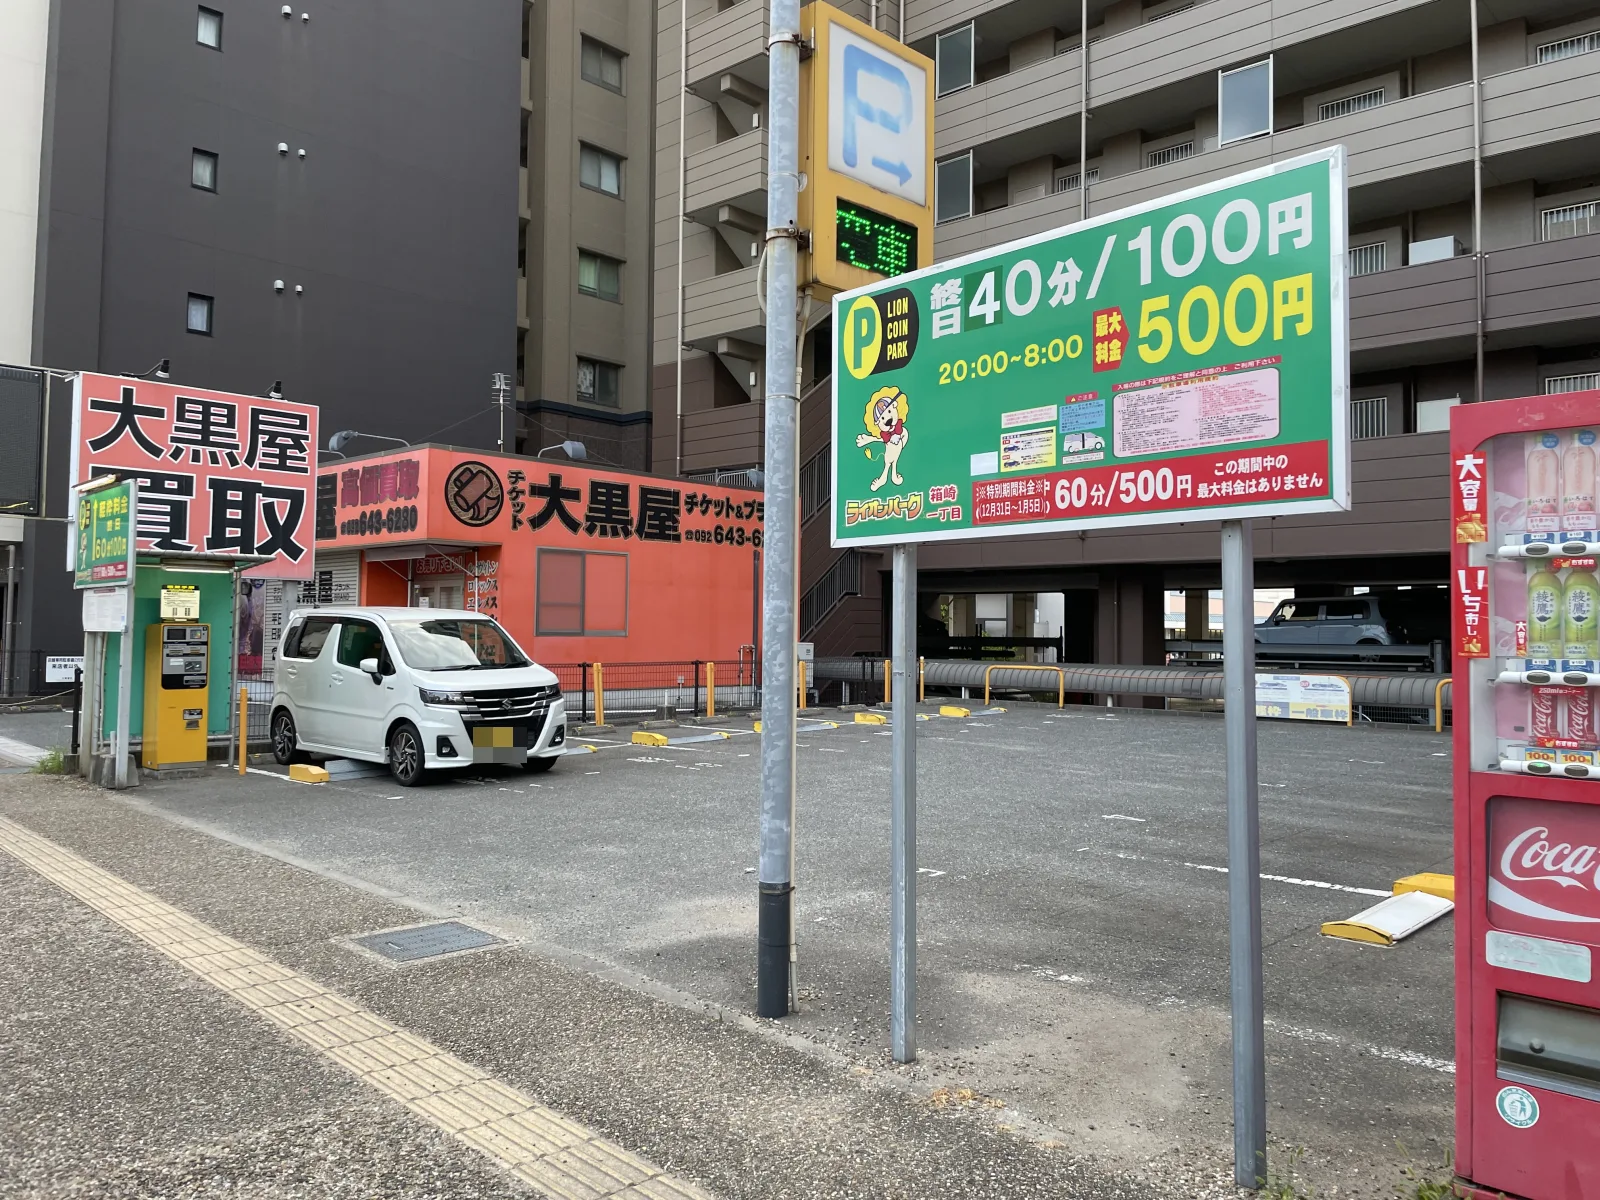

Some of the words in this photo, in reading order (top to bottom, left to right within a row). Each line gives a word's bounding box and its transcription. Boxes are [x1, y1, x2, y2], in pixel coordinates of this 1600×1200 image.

[887, 297, 909, 318] LION
[1137, 272, 1313, 365] 500円
[887, 319, 909, 340] COIN
[1095, 312, 1122, 338] 最大
[887, 341, 909, 361] PARK
[1095, 338, 1122, 364] 料金
[86, 384, 311, 475] 大黒屋
[1214, 454, 1288, 476] この期間中の
[341, 459, 419, 509] 高価買取
[929, 484, 959, 503] 箱崎
[1197, 472, 1323, 499] 最大料金はありません
[89, 463, 308, 564] 買取
[507, 470, 526, 531] チケット
[526, 473, 681, 543] 大黒屋
[845, 492, 924, 527] ライオンパーク
[926, 506, 963, 522] 一丁目
[695, 529, 712, 542] 092
[1457, 569, 1485, 636] いちおし
[1535, 590, 1549, 615] 綾鷹
[1572, 590, 1586, 615] 綾鷹
